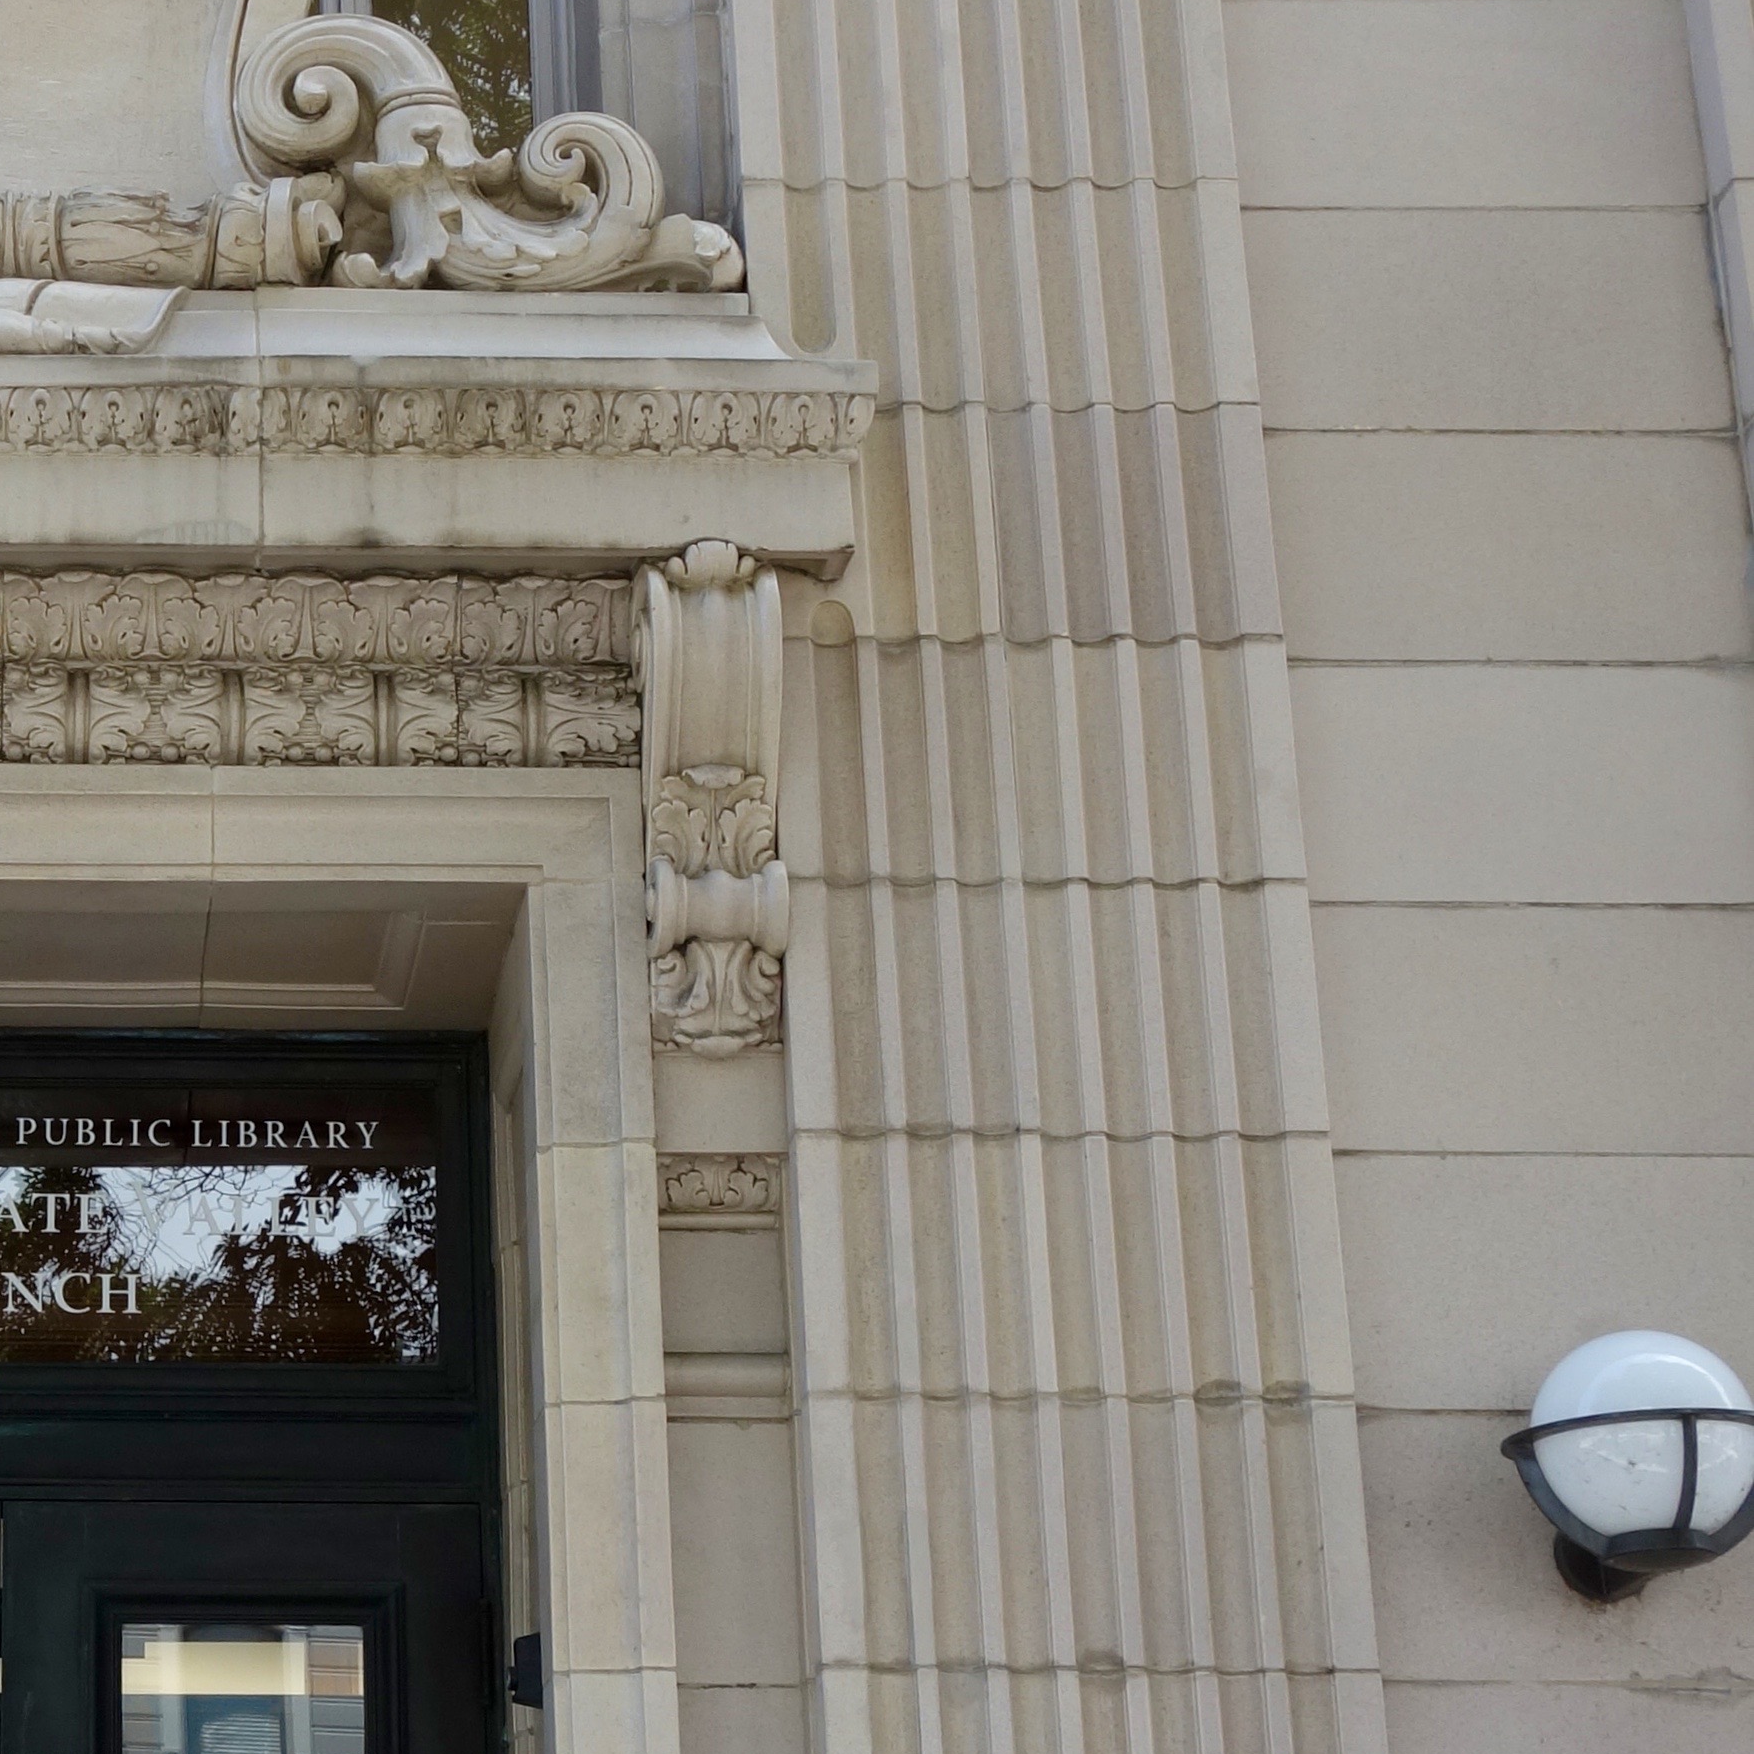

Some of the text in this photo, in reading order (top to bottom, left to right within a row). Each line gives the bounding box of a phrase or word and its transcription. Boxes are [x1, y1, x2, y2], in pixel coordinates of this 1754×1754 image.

[15, 1117, 171, 1147] PUBLIC
[191, 1120, 380, 1150] LIBRARY
[130, 1180, 380, 1238] VALLEY
